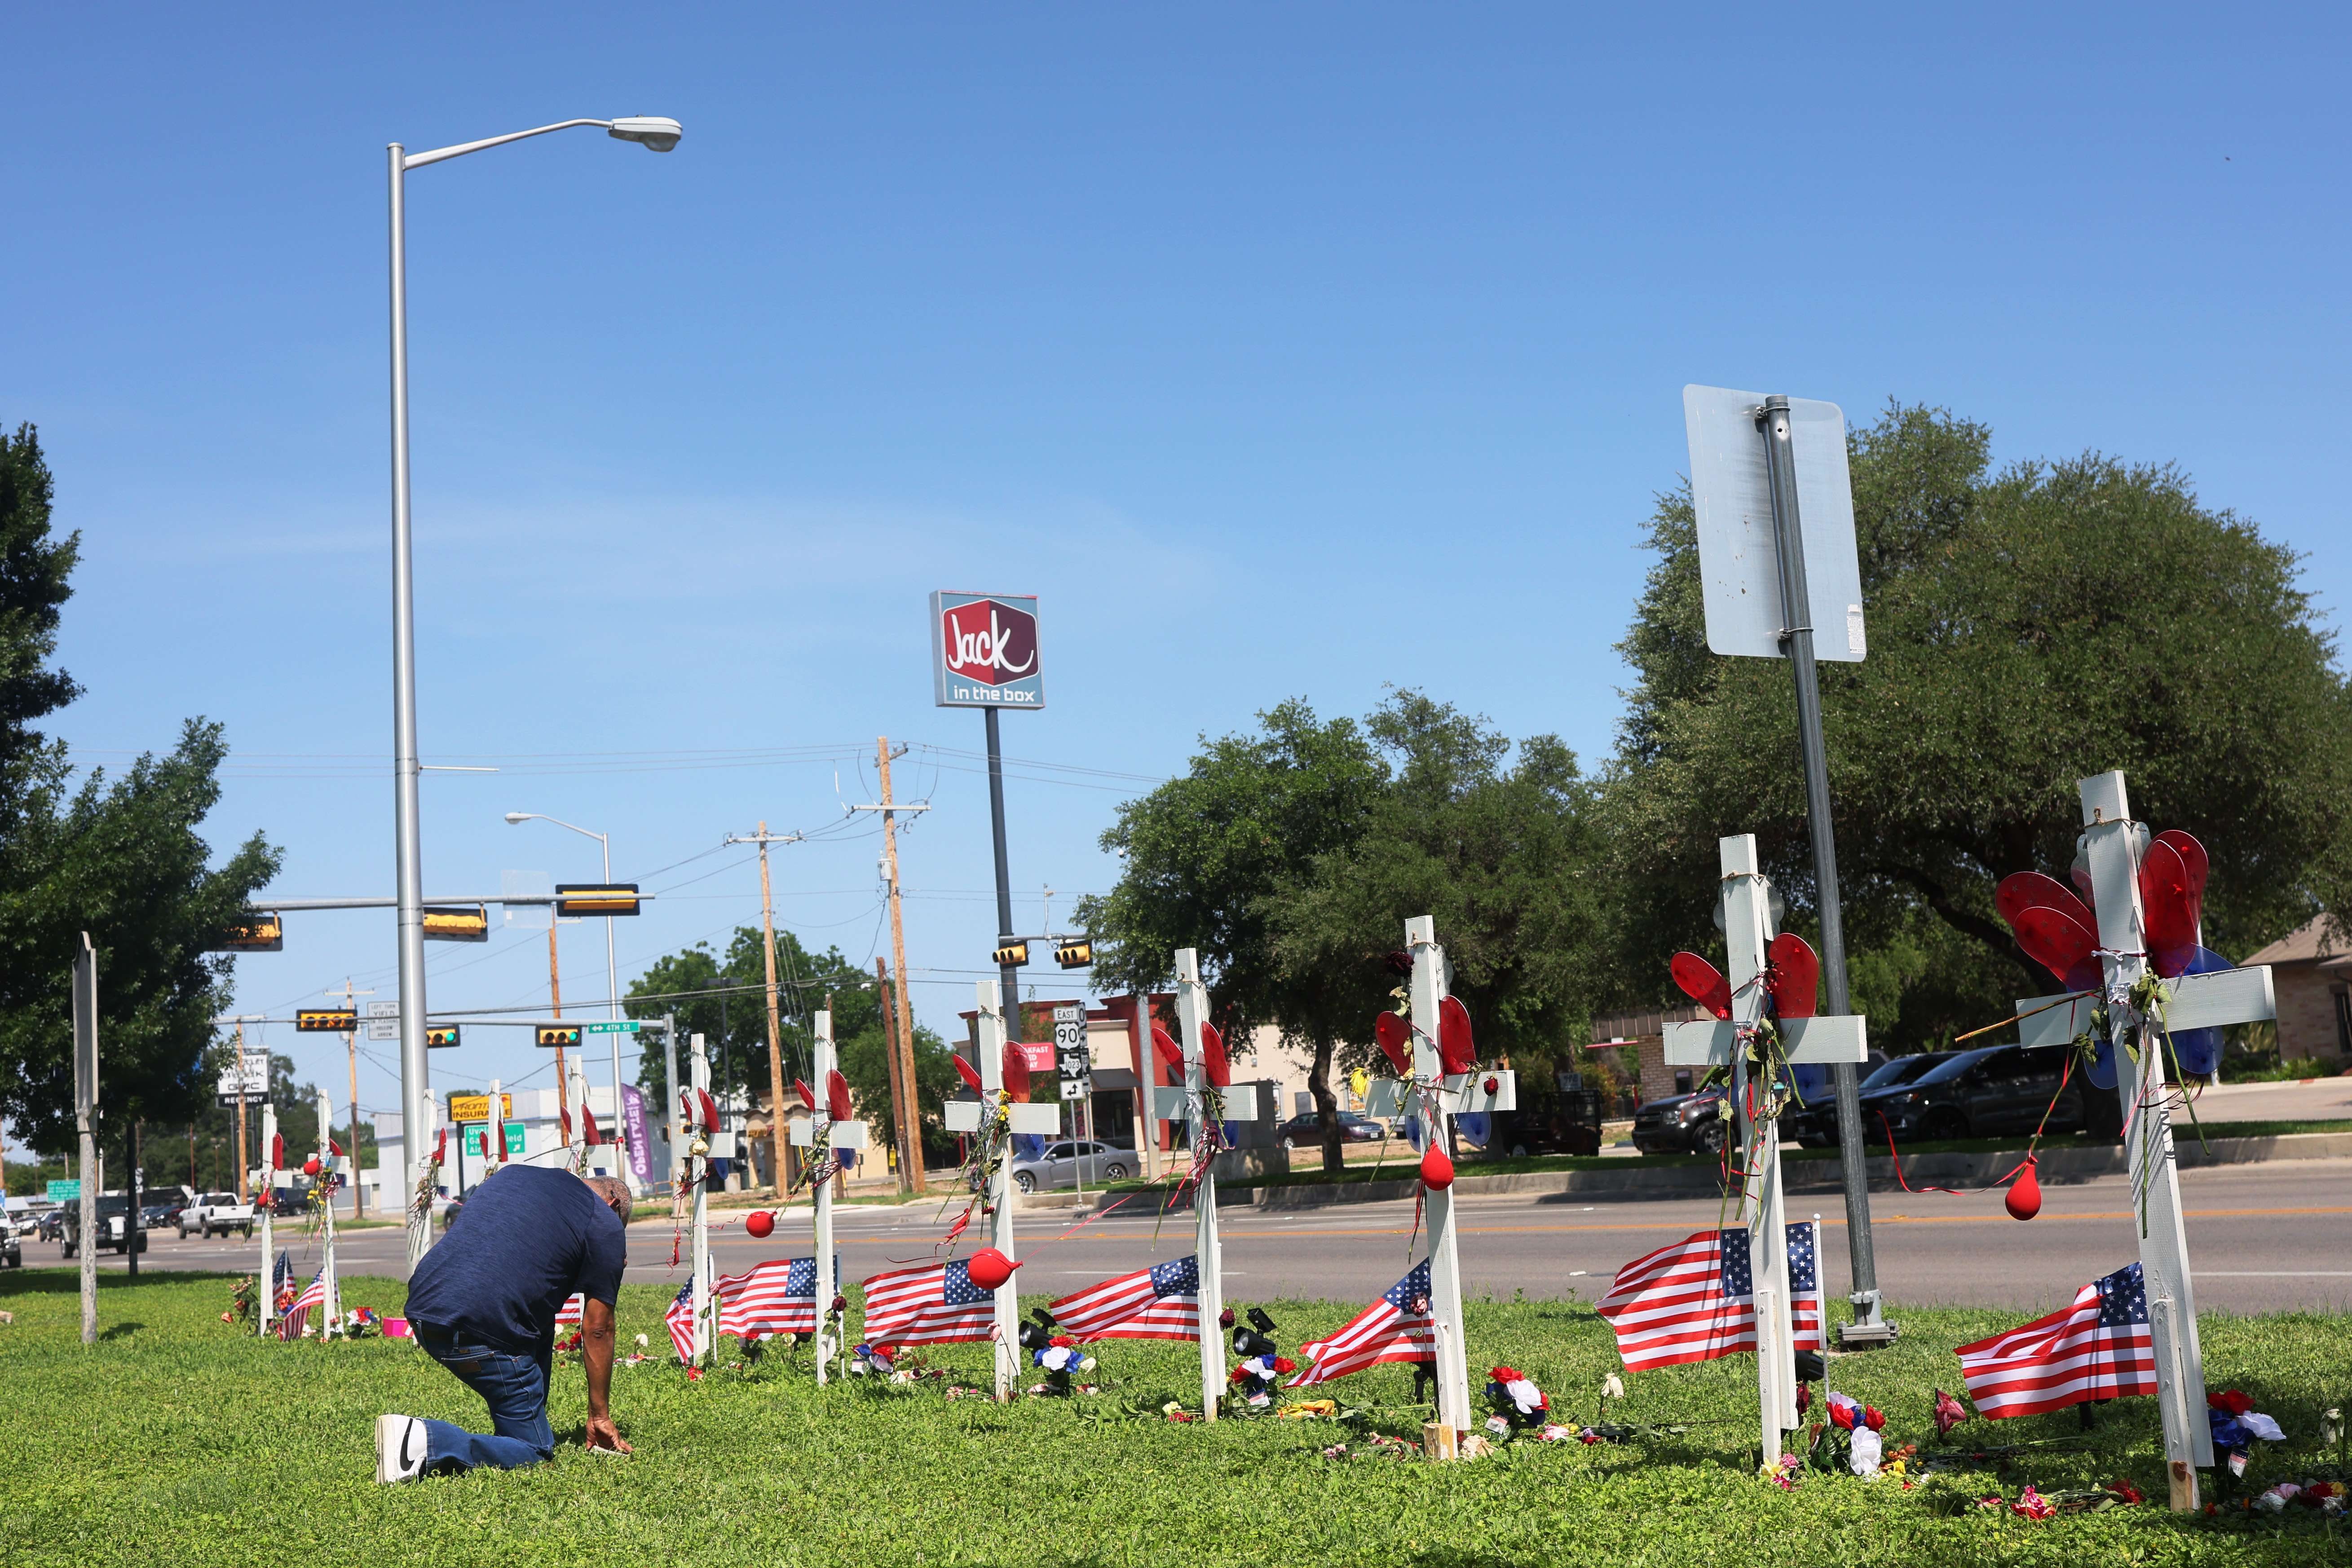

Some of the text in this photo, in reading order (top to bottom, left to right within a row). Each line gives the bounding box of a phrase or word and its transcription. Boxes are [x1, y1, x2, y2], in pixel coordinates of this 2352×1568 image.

[948, 610, 1034, 672] Jack
[954, 685, 1035, 702] in the box
[1057, 1011, 1074, 1019] EAST
[1079, 1008, 1085, 1022] 0
[1058, 1028, 1077, 1043] 90
[1065, 1060, 1080, 1069] 1023
[453, 1109, 511, 1118] INSURAE
